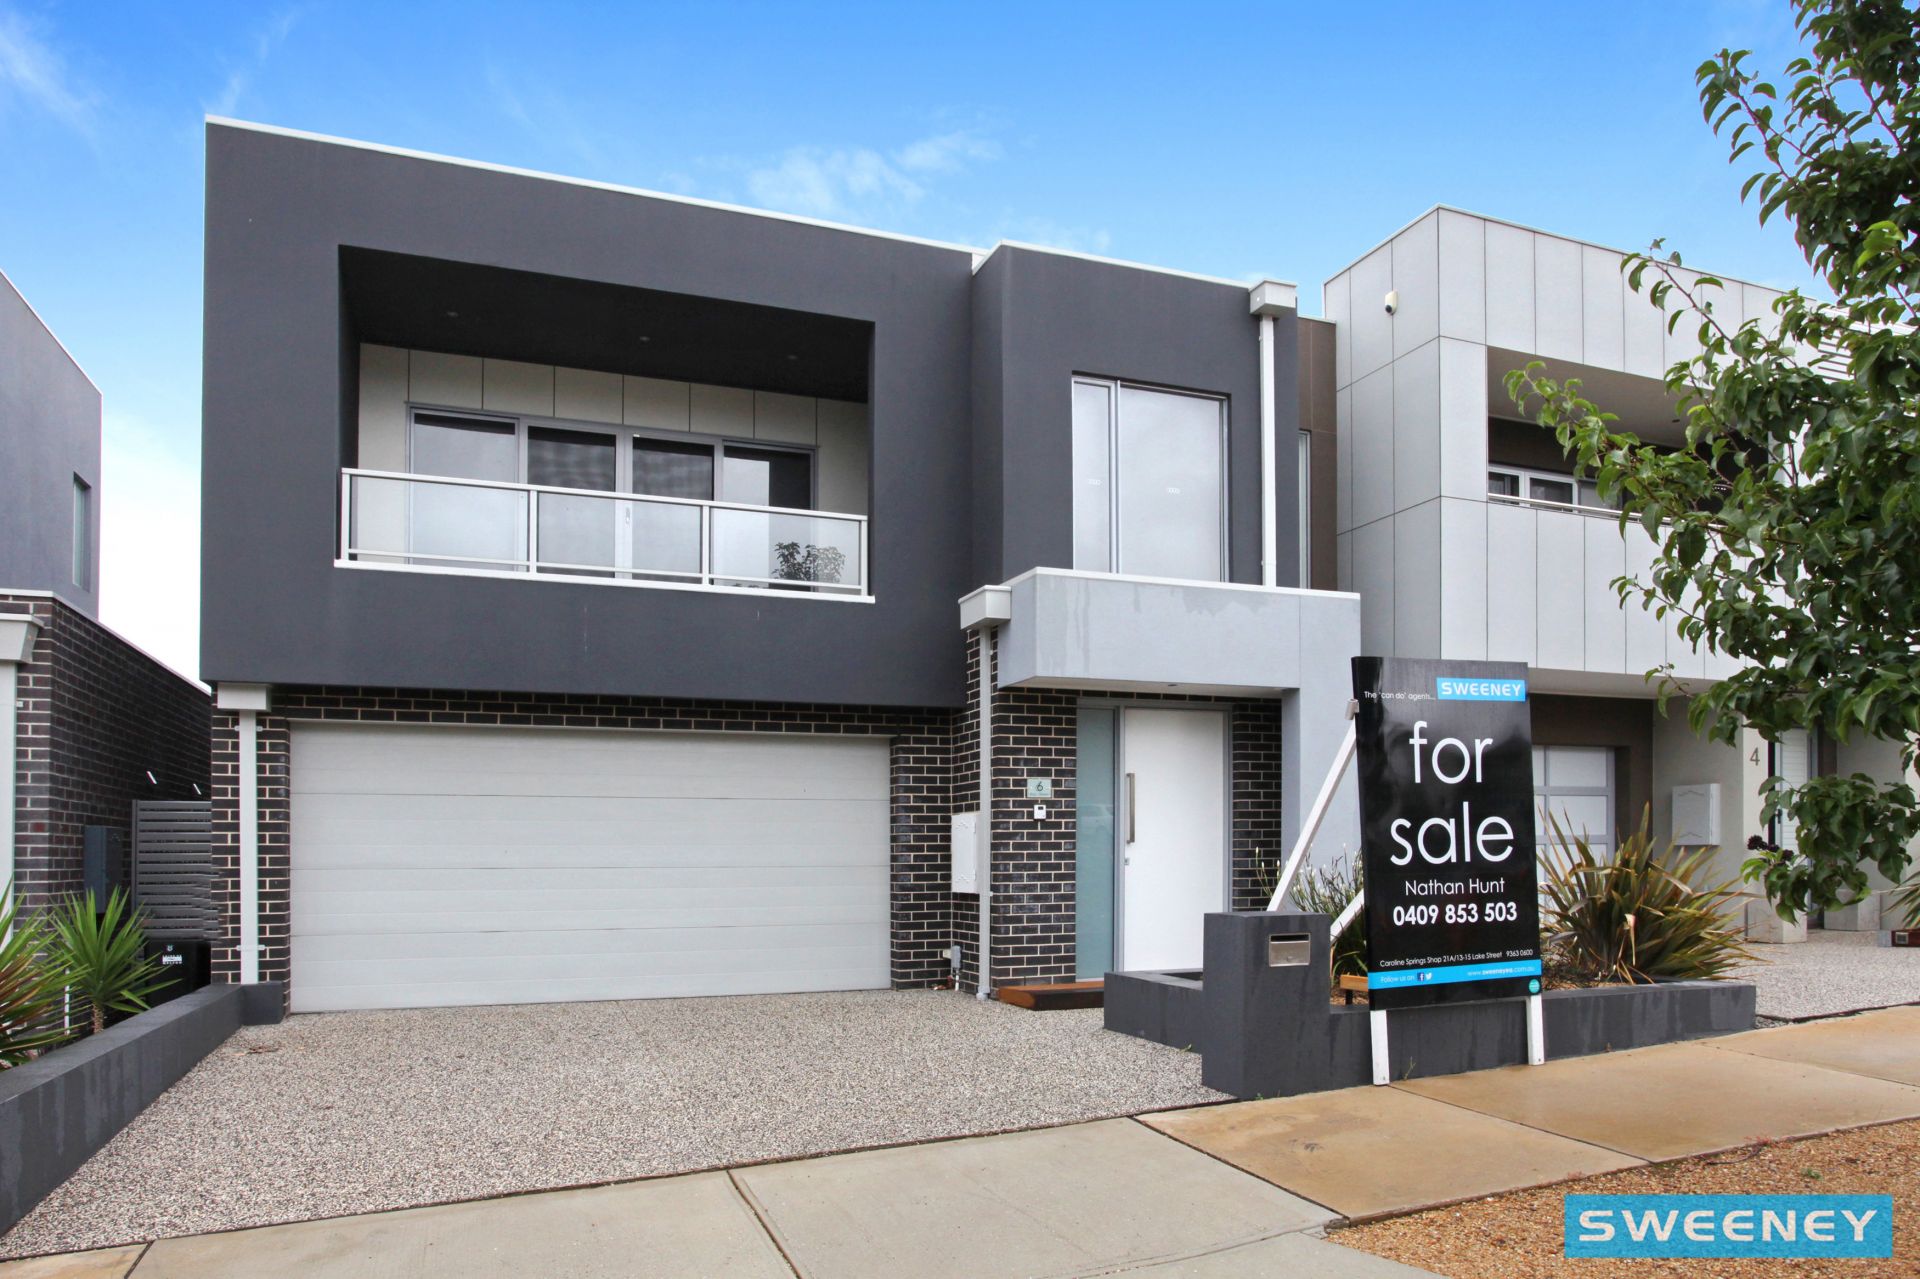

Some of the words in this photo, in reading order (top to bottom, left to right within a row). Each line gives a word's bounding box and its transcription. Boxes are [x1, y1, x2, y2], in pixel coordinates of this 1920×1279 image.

[1364, 691, 1377, 699] The
[1441, 682, 1521, 697] SWEENEY
[1409, 721, 1493, 784] for
[1750, 747, 1760, 766] 4
[1037, 781, 1043, 792] 6
[1390, 801, 1514, 866] sale
[1405, 879, 1465, 896] Nathan
[1469, 877, 1505, 894] Hunt
[1393, 904, 1439, 926] 0409
[1445, 903, 1478, 924] 853
[1484, 901, 1517, 922] 503
[1380, 959, 1404, 967] Caroline
[1406, 957, 1426, 966] Springs
[1427, 956, 1442, 965] Shop
[1443, 954, 1471, 963] 21A/13-15
[1486, 951, 1502, 959] Street
